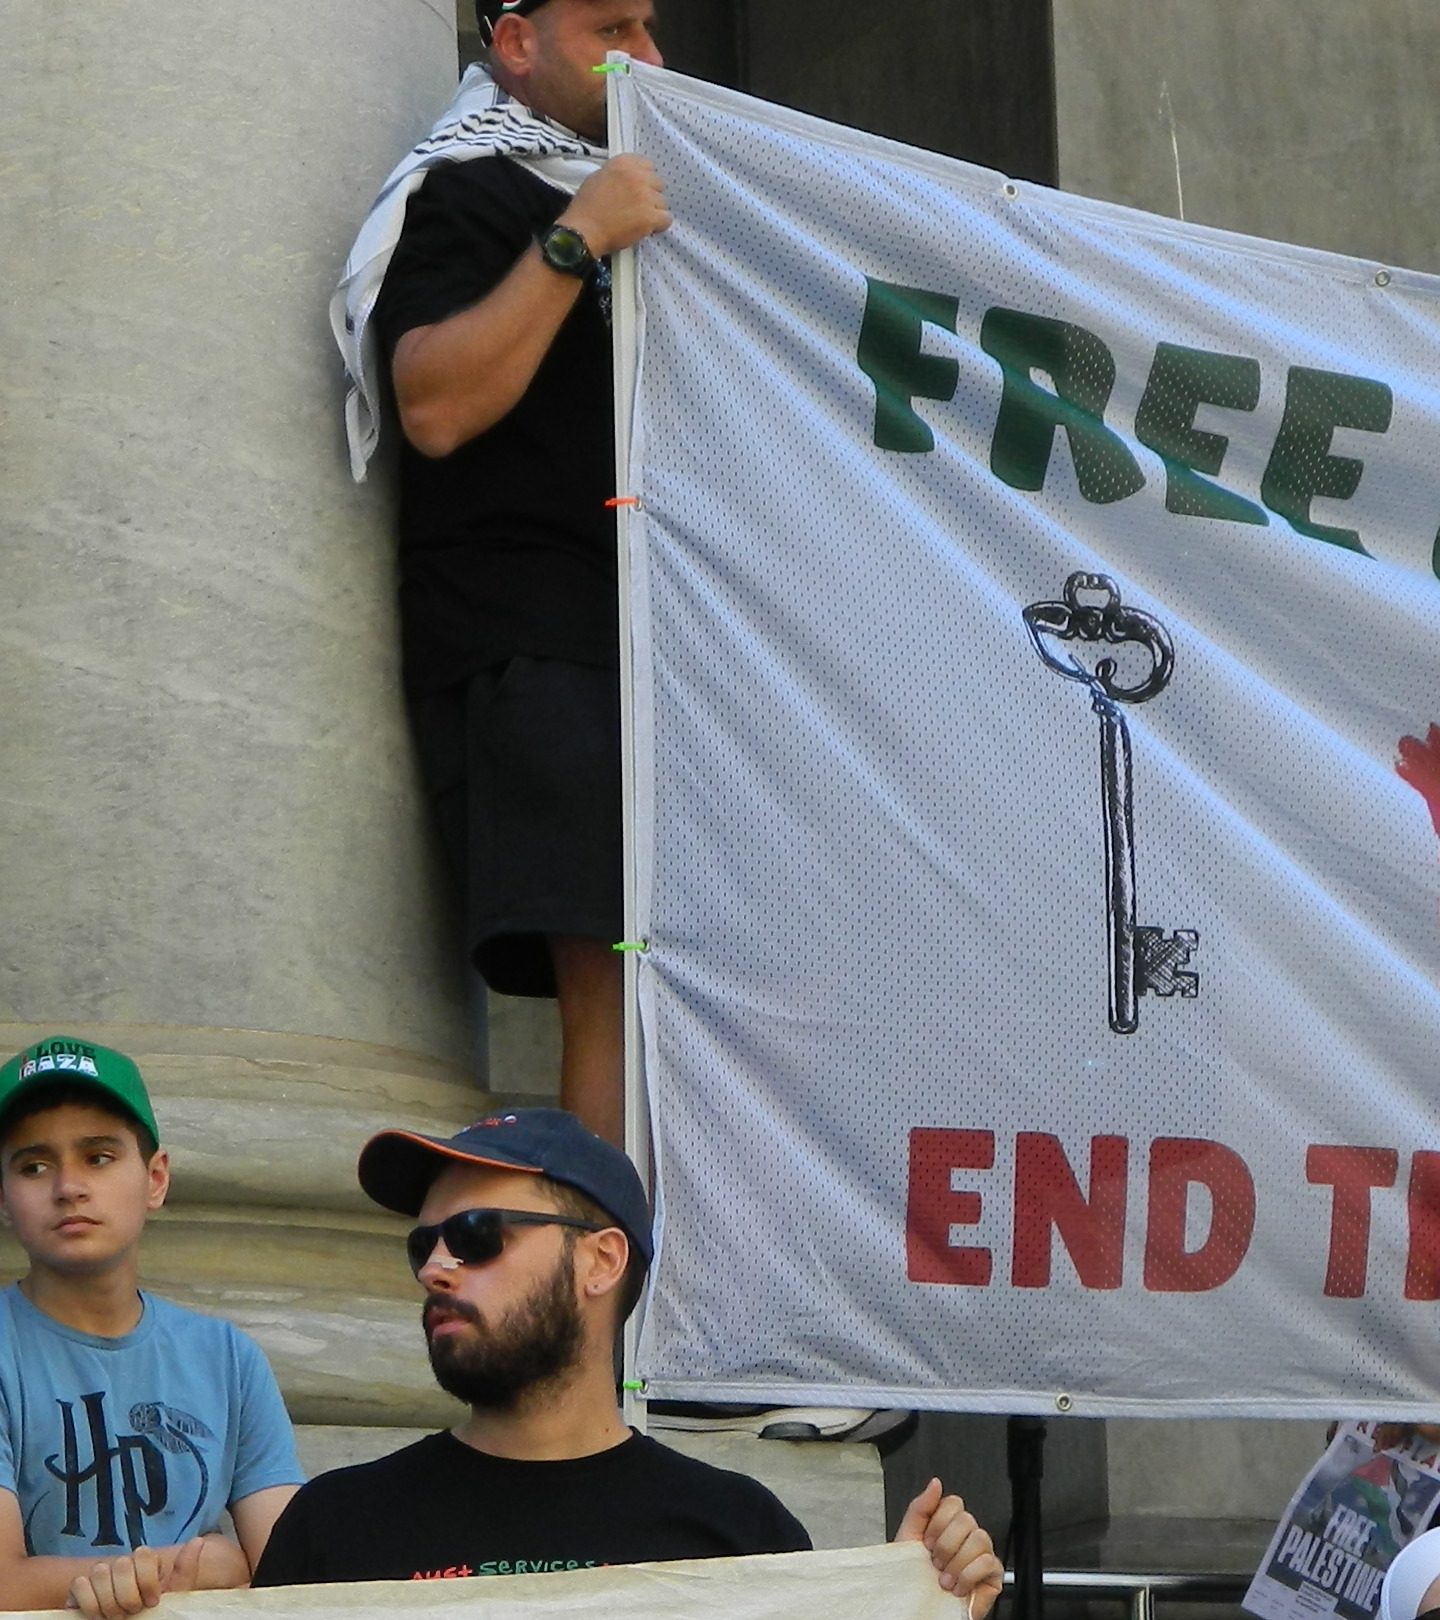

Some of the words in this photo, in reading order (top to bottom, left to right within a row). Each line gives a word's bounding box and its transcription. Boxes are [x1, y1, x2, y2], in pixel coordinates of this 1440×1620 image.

[857, 278, 1393, 560] FREE
[19, 1054, 99, 1081] GAZA
[36, 1041, 97, 1060] LOVE
[907, 1128, 1253, 1291] END
[1322, 1503, 1378, 1558] FREE
[1277, 1524, 1387, 1612] PALESTINE
